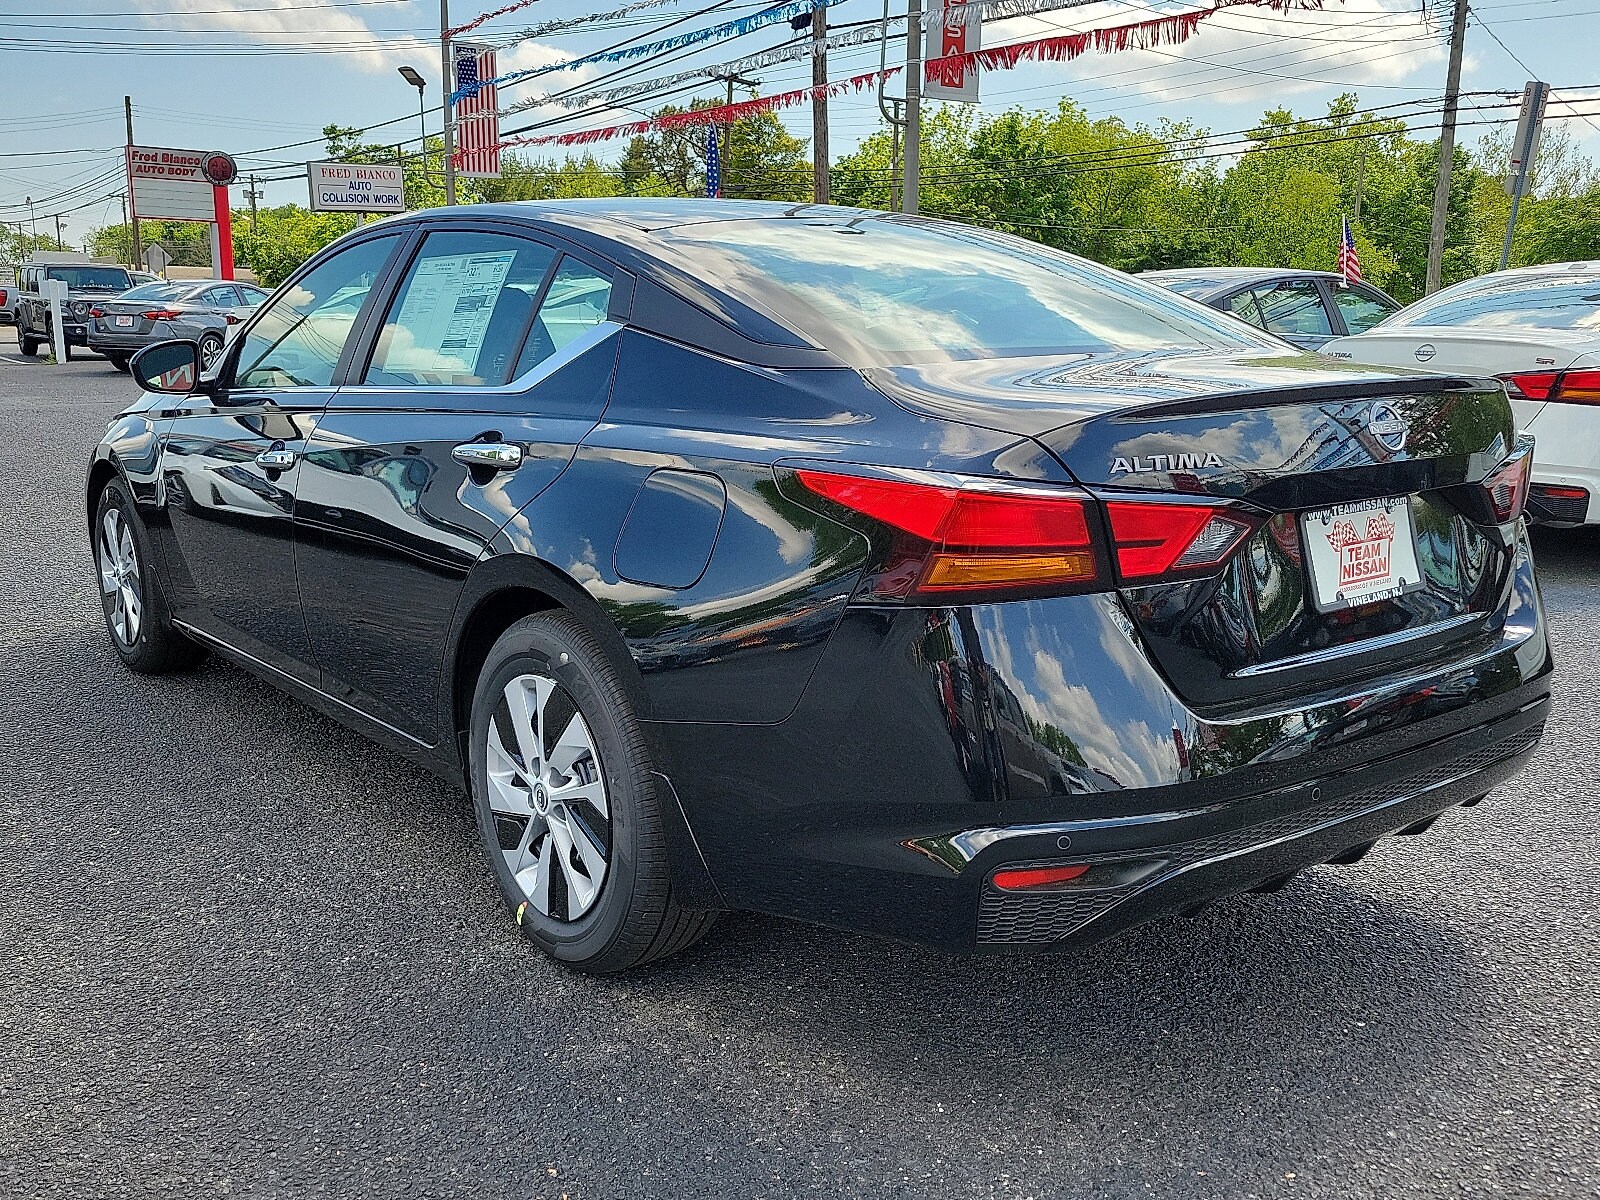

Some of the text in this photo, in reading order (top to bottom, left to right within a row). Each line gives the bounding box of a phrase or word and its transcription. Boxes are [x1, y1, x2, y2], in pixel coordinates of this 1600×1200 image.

[1521, 88, 1531, 117] BUS
[1535, 89, 1548, 128] STOP
[132, 151, 158, 162] Fred
[135, 165, 197, 176] AUTO BODY
[321, 167, 396, 180] FRED BIANCO
[348, 181, 372, 191] AUTO
[322, 192, 400, 204] COLLISION WORK
[1535, 357, 1555, 366] SR
[1370, 421, 1410, 433] NISSAN
[1109, 452, 1224, 474] ALTIMA
[1348, 543, 1381, 562] TEAM
[1342, 557, 1387, 580] NISSAN
[1392, 586, 1404, 597] NJ
